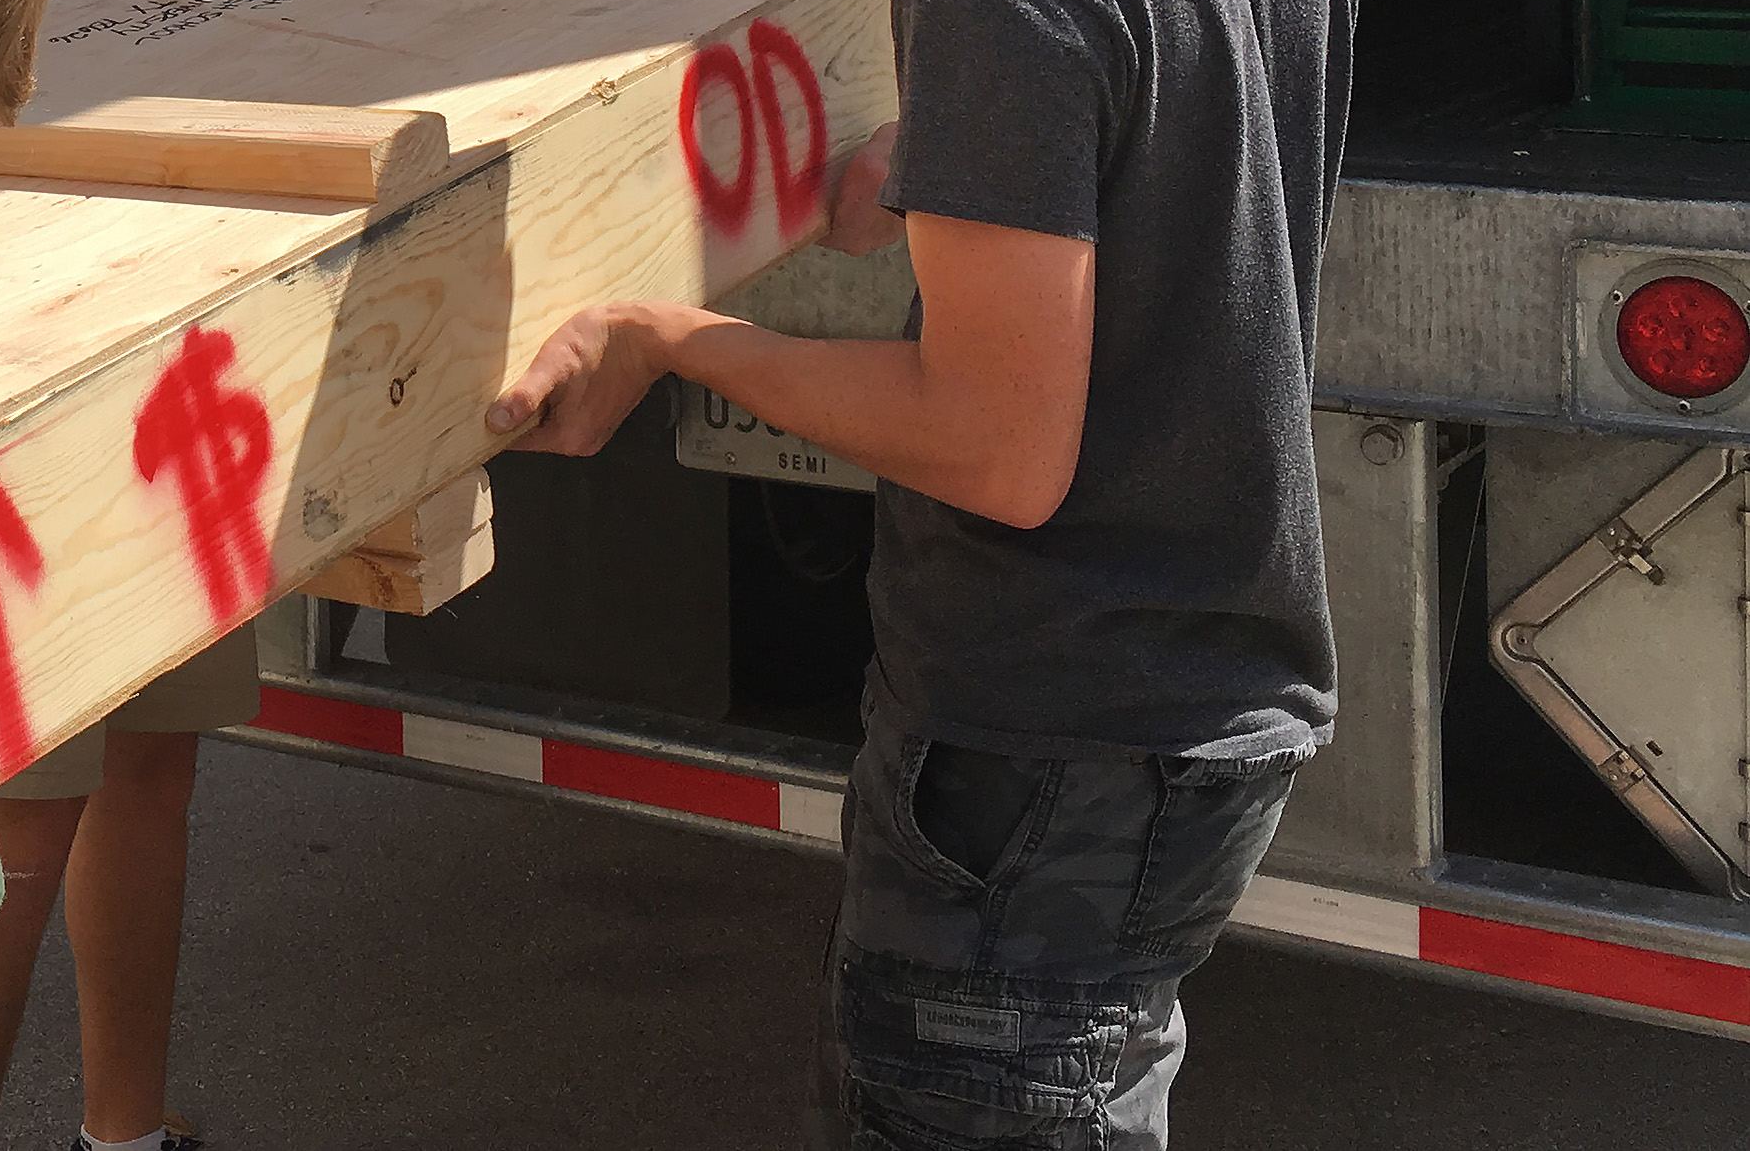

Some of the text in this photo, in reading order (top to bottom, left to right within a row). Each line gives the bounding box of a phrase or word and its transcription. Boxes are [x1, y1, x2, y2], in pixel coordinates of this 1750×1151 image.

[126, 0, 178, 15] TX
[134, 11, 223, 46] SCHOOL
[678, 17, 828, 240] OD
[778, 452, 827, 474] SEMI
